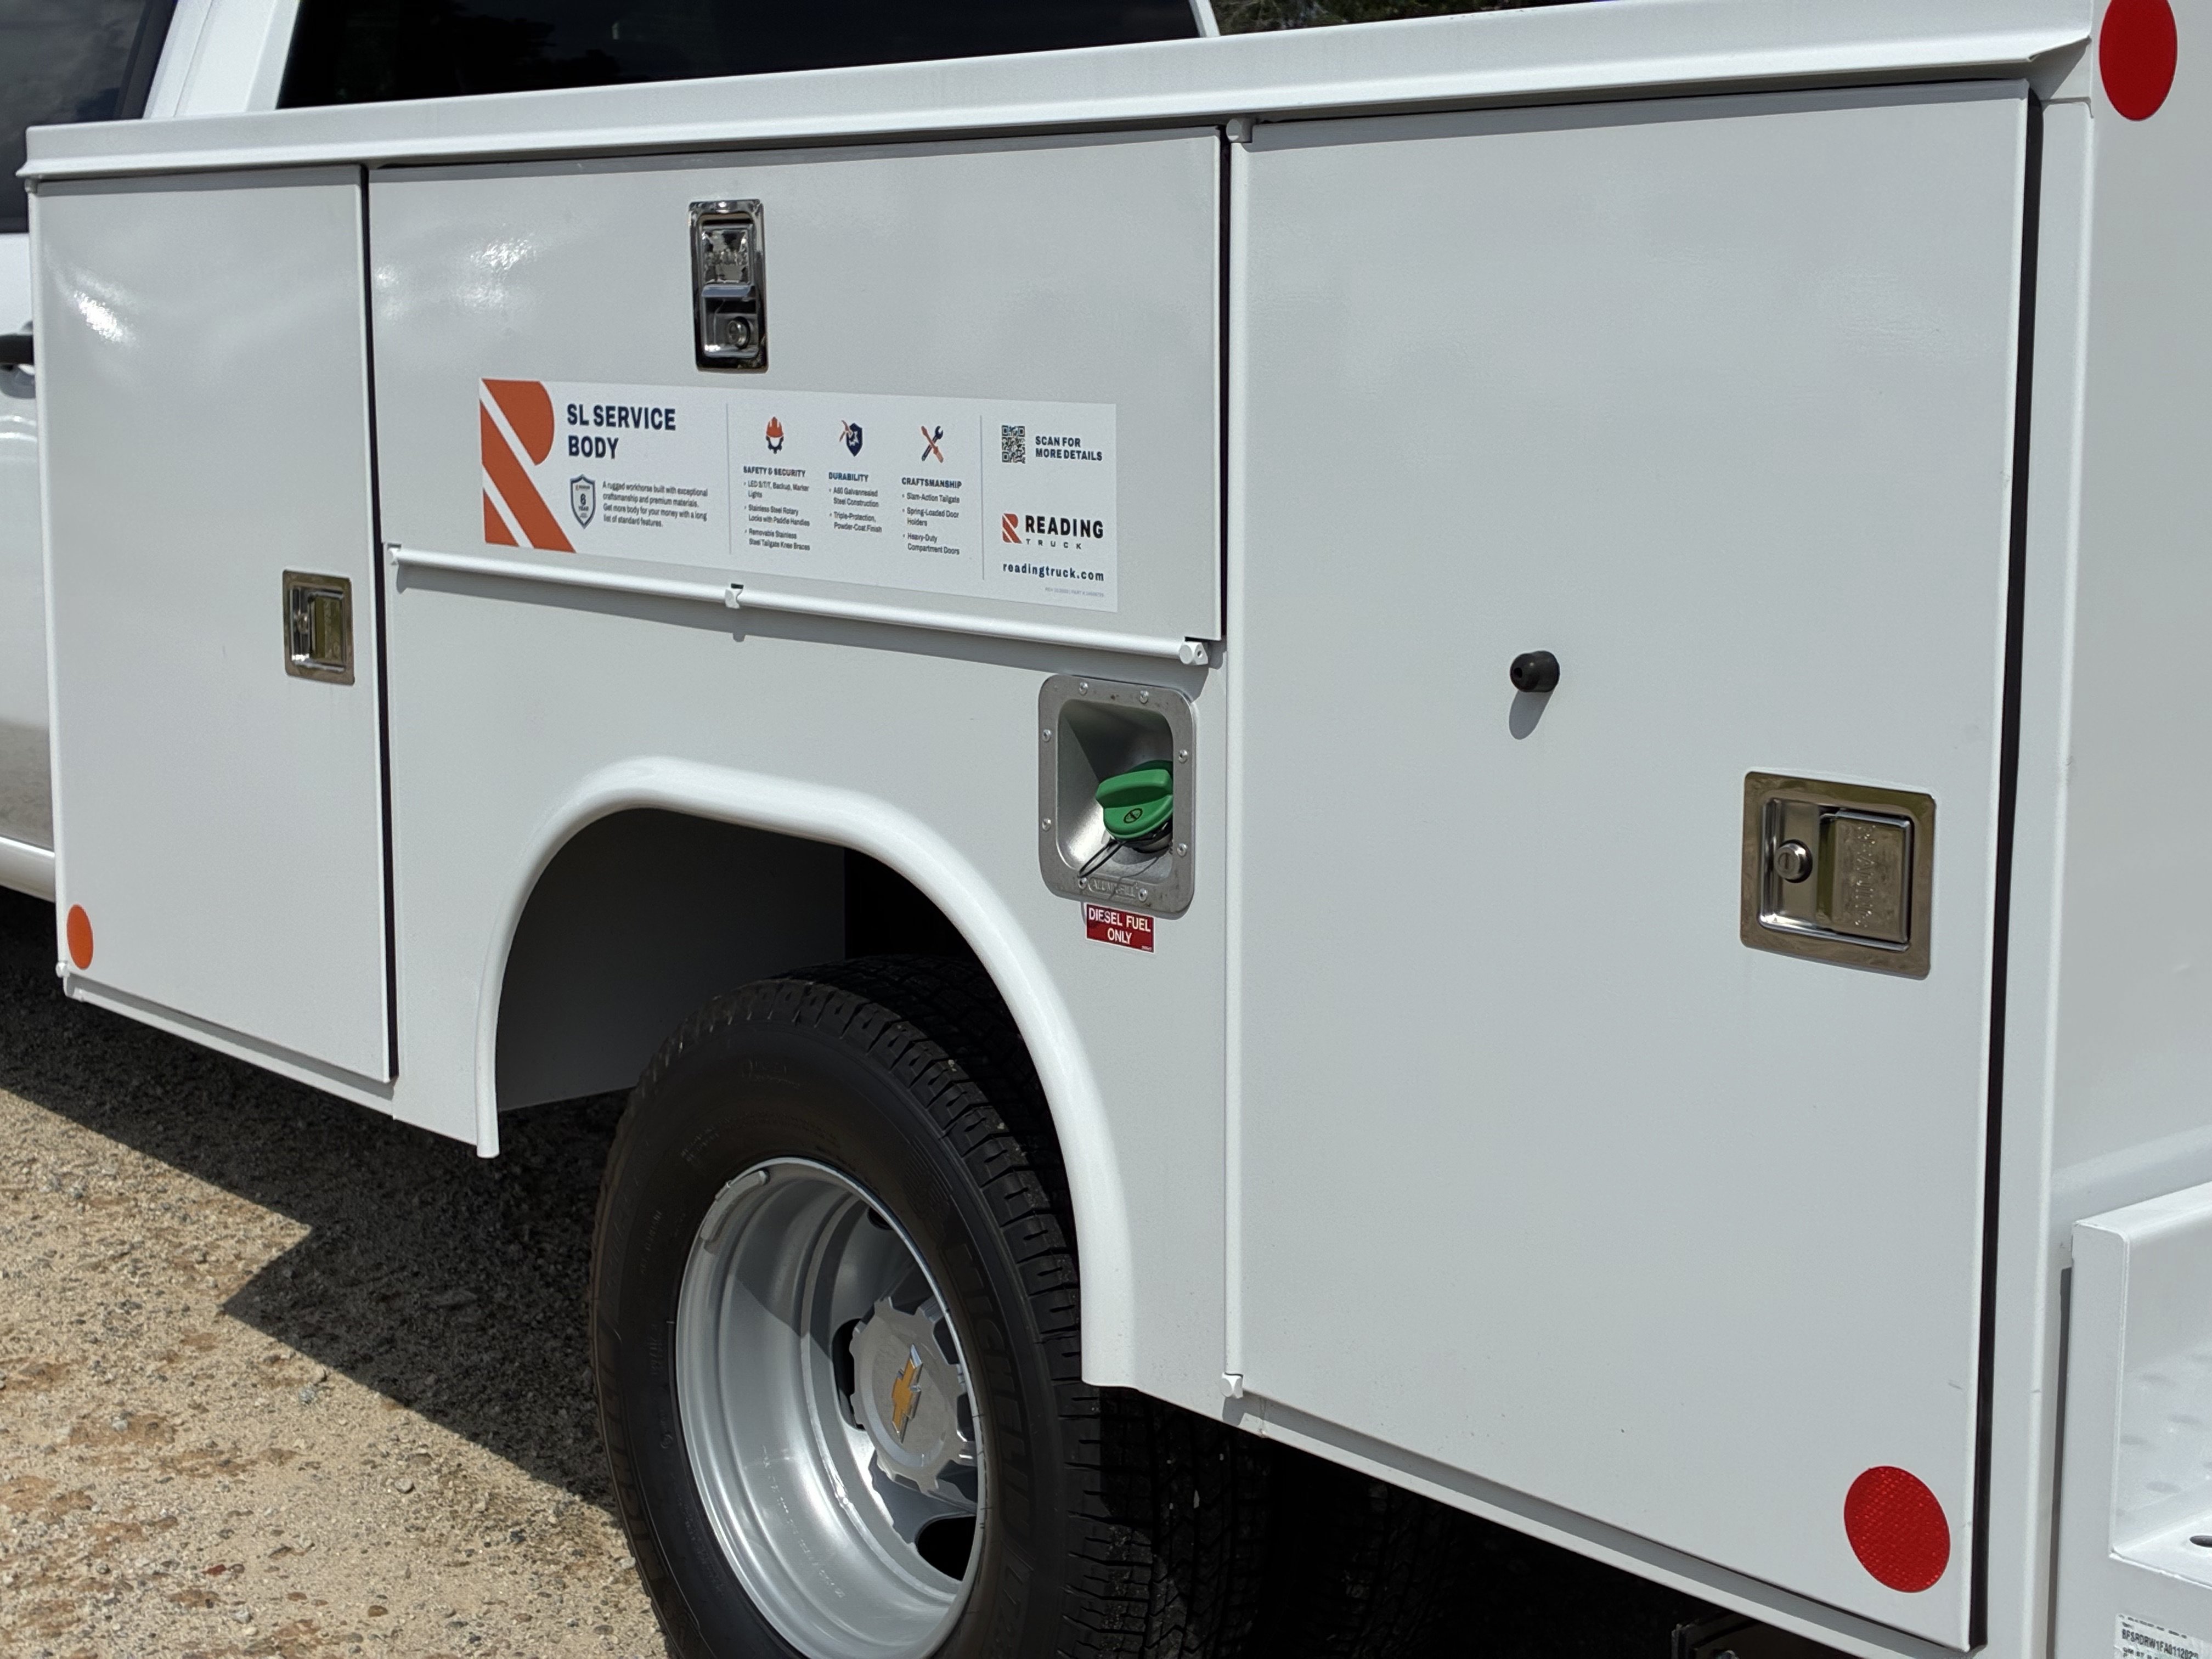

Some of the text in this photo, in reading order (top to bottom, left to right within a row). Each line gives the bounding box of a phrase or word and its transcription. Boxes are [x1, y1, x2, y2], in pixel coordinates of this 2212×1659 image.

[567, 404, 676, 431] SL SERVICE
[568, 435, 619, 459] BODY
[1036, 436, 1081, 448] SCAN FOR
[1036, 448, 1103, 461] MORE DETAILS
[743, 466, 767, 475] SAFETY
[774, 468, 806, 478] SECURITY
[828, 472, 869, 482] DURABILITY
[902, 477, 962, 488] CRAFTSMANSHIP
[607, 483, 625, 492] rugged
[626, 484, 652, 493] workhorse
[654, 484, 665, 493] built
[677, 488, 708, 497] exceptional
[748, 490, 762, 499] Lights
[603, 493, 638, 504] craftsmanship
[639, 495, 648, 503] and
[673, 499, 699, 507] materials.
[847, 498, 879, 508] Construction
[907, 493, 960, 504] Slam-Action Tailgate
[603, 503, 612, 511] Get
[627, 505, 640, 515] body
[648, 508, 659, 517] your
[661, 509, 678, 519] money
[695, 511, 707, 522] long
[748, 504, 769, 512] Stainless
[782, 507, 799, 517] Rotary
[907, 507, 945, 517] Spring-Loaded
[618, 516, 640, 525] standard
[641, 518, 663, 527] features.
[774, 516, 790, 524] Paddle
[791, 518, 810, 527] Handles
[834, 522, 882, 533] Powder-Coat Finish
[907, 518, 927, 527] Holders
[1025, 515, 1104, 539] READING
[749, 528, 797, 540] Removable Stainless
[907, 533, 938, 544] Heavy-Duty
[761, 539, 780, 549] Tailgate
[793, 543, 810, 551] Braces
[907, 543, 960, 555] Compartment Doors
[1026, 539, 1082, 550] TRUCK
[1003, 563, 1104, 582] readingtruck.com
[1088, 907, 1151, 932] DIESEL FUEL
[1108, 928, 1132, 944] ONLY
[941, 1244, 1030, 1537] MICHELIN
